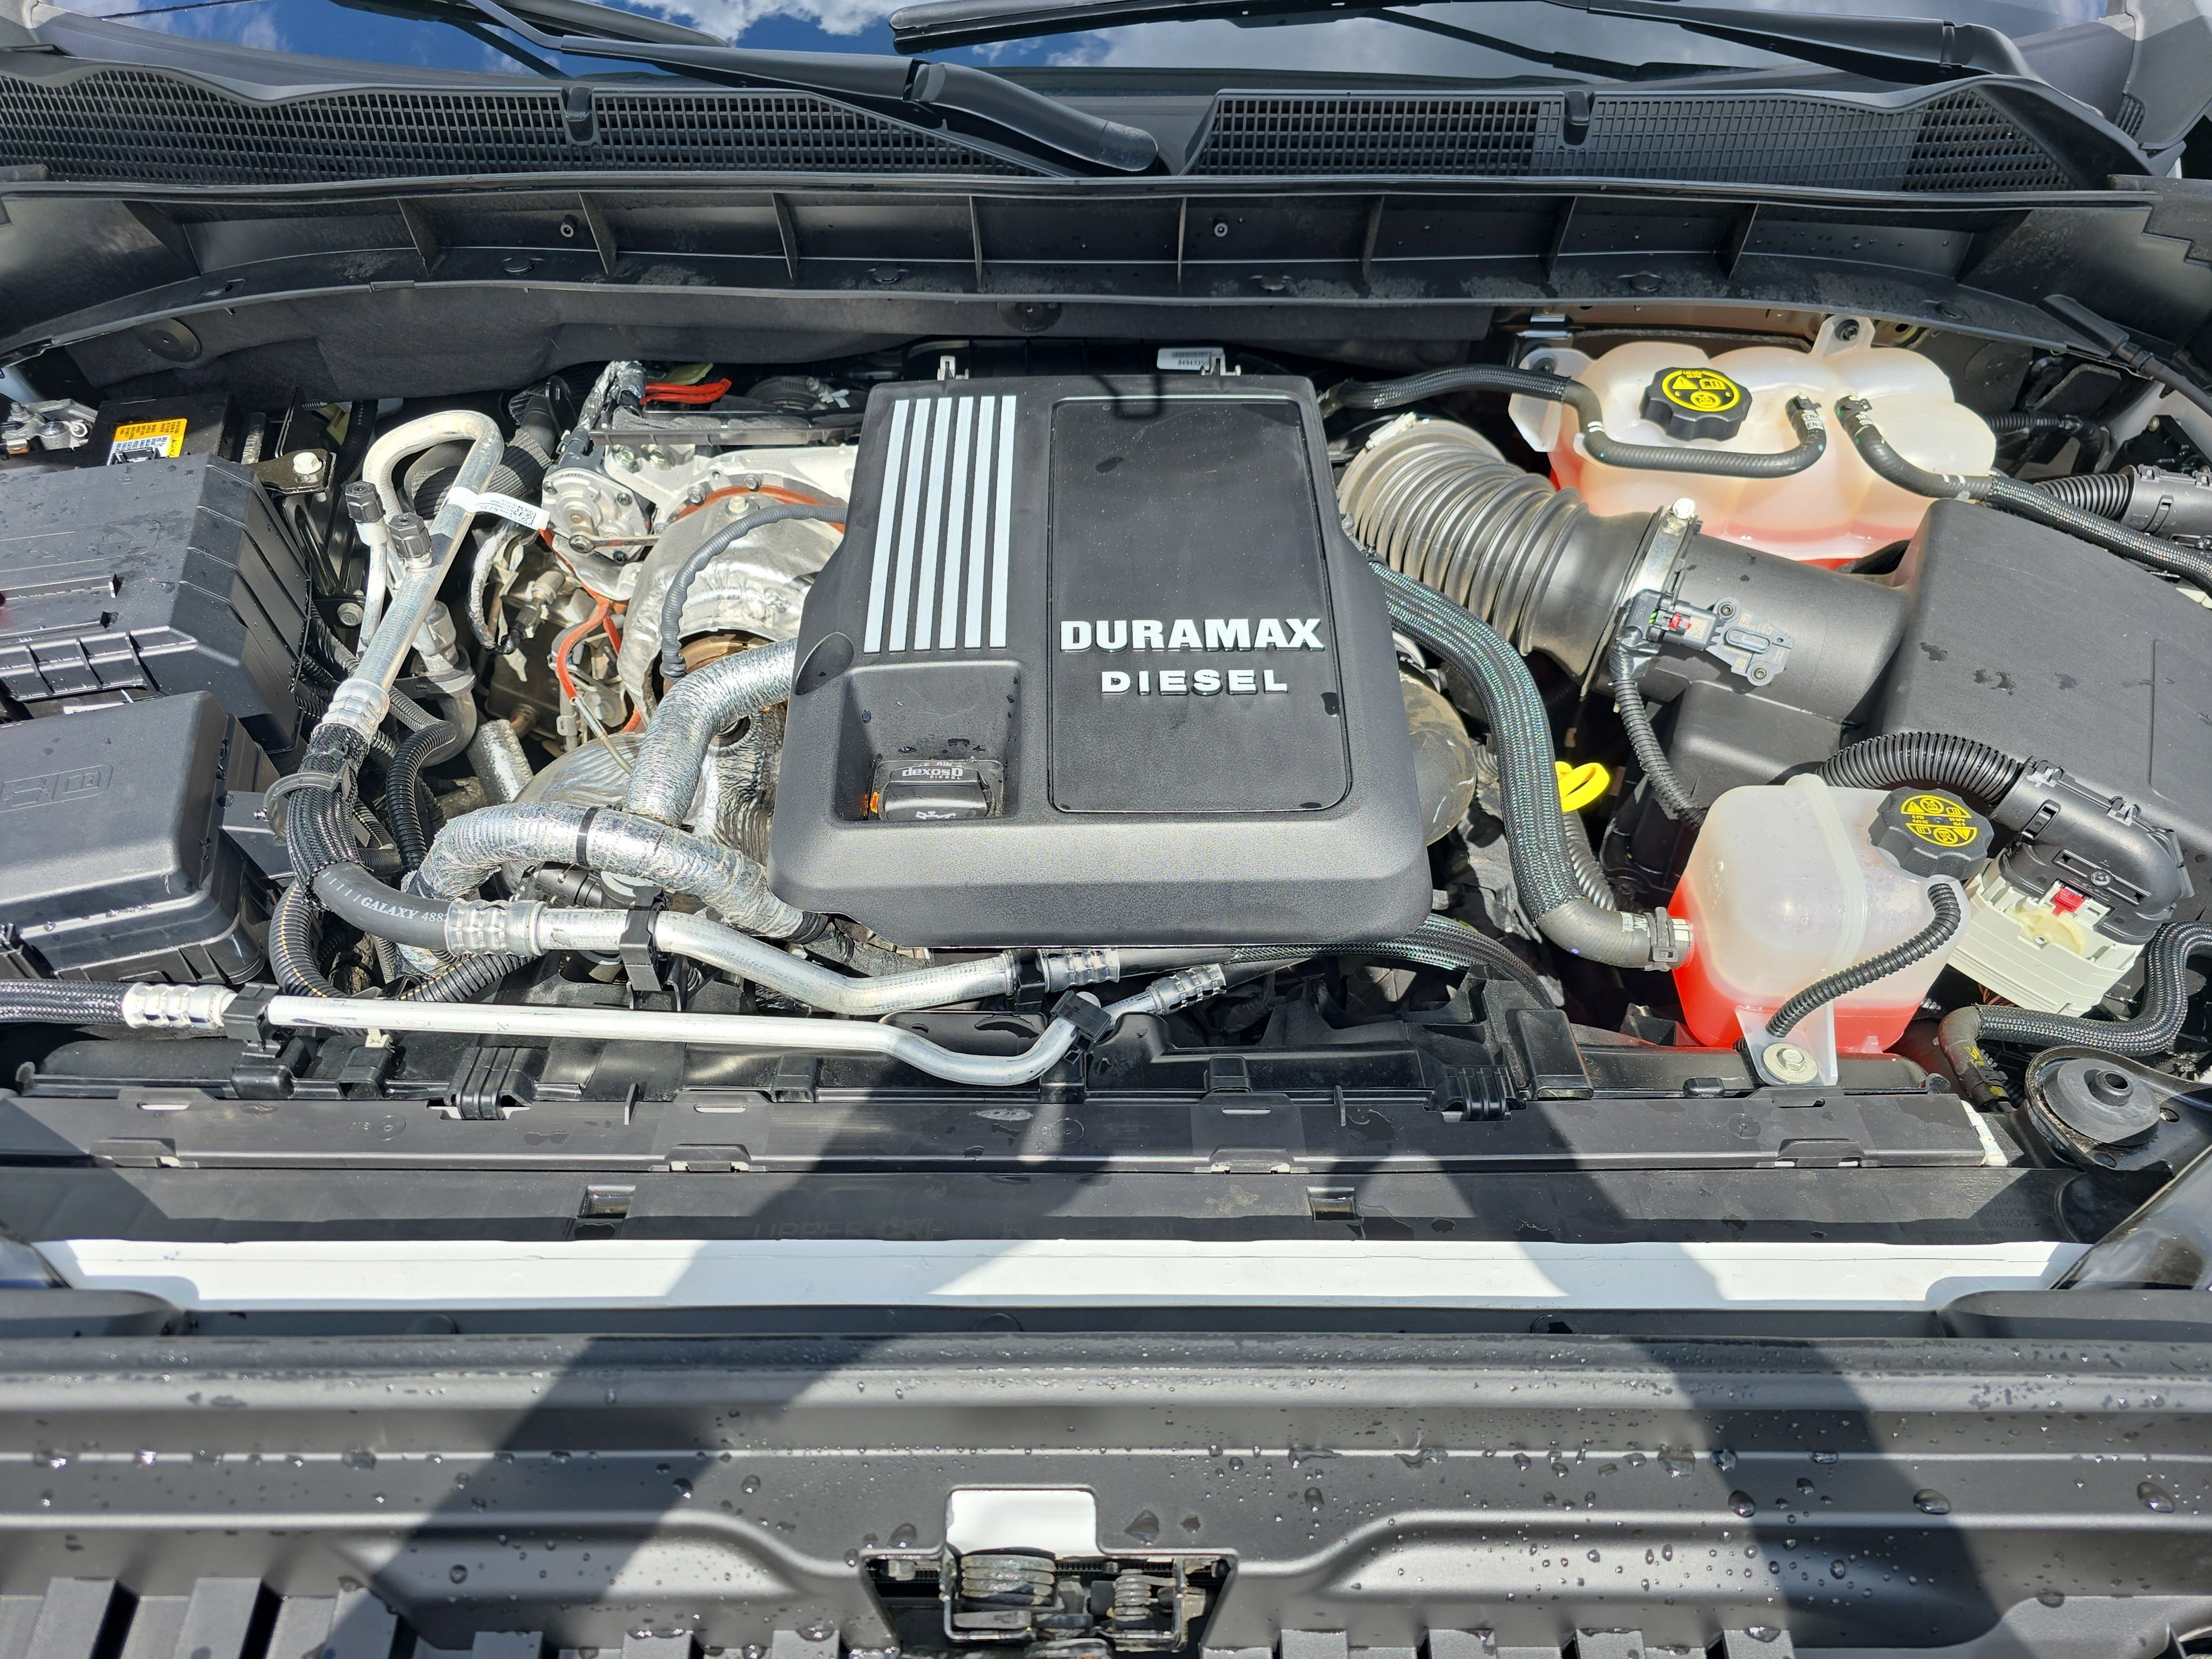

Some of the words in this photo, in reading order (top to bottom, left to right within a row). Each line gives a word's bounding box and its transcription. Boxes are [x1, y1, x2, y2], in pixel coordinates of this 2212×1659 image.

[1060, 619, 1325, 652] DURAMAX
[1101, 669, 1288, 696] DIESEL
[361, 897, 419, 919] GALAXY
